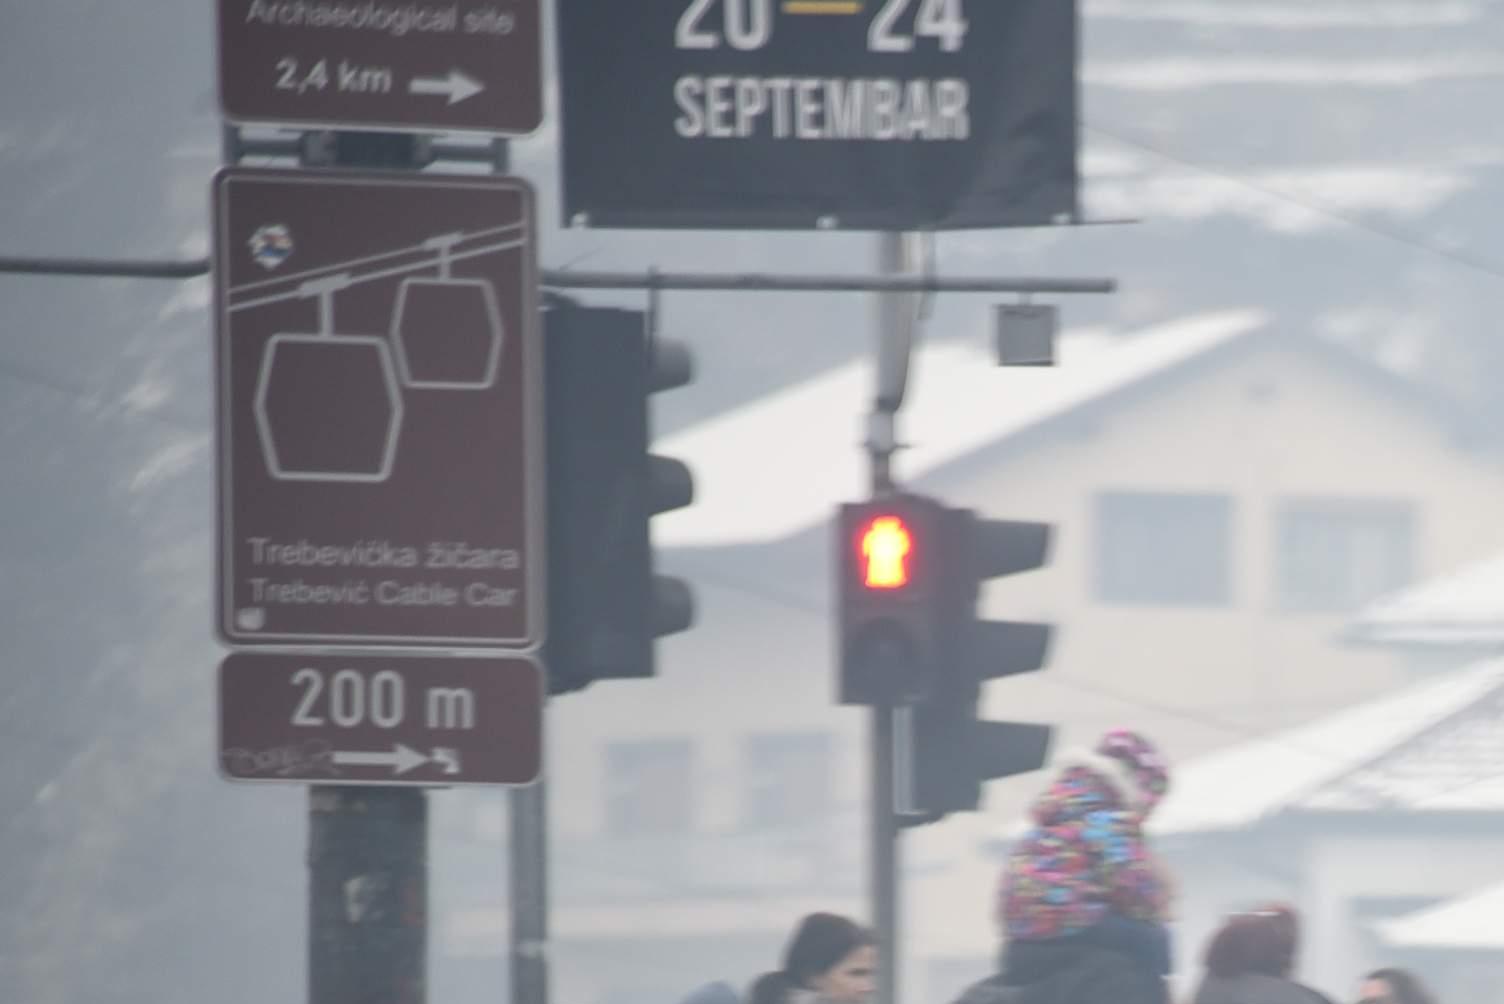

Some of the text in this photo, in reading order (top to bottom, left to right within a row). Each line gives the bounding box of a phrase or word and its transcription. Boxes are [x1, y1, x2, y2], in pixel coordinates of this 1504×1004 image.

[463, 7, 515, 36] site
[275, 55, 393, 94] 2,4 km
[673, 75, 970, 141] SEPTEMBAR
[374, 580, 458, 606] Cable
[463, 582, 517, 607] Car
[289, 667, 475, 729] 200 m
